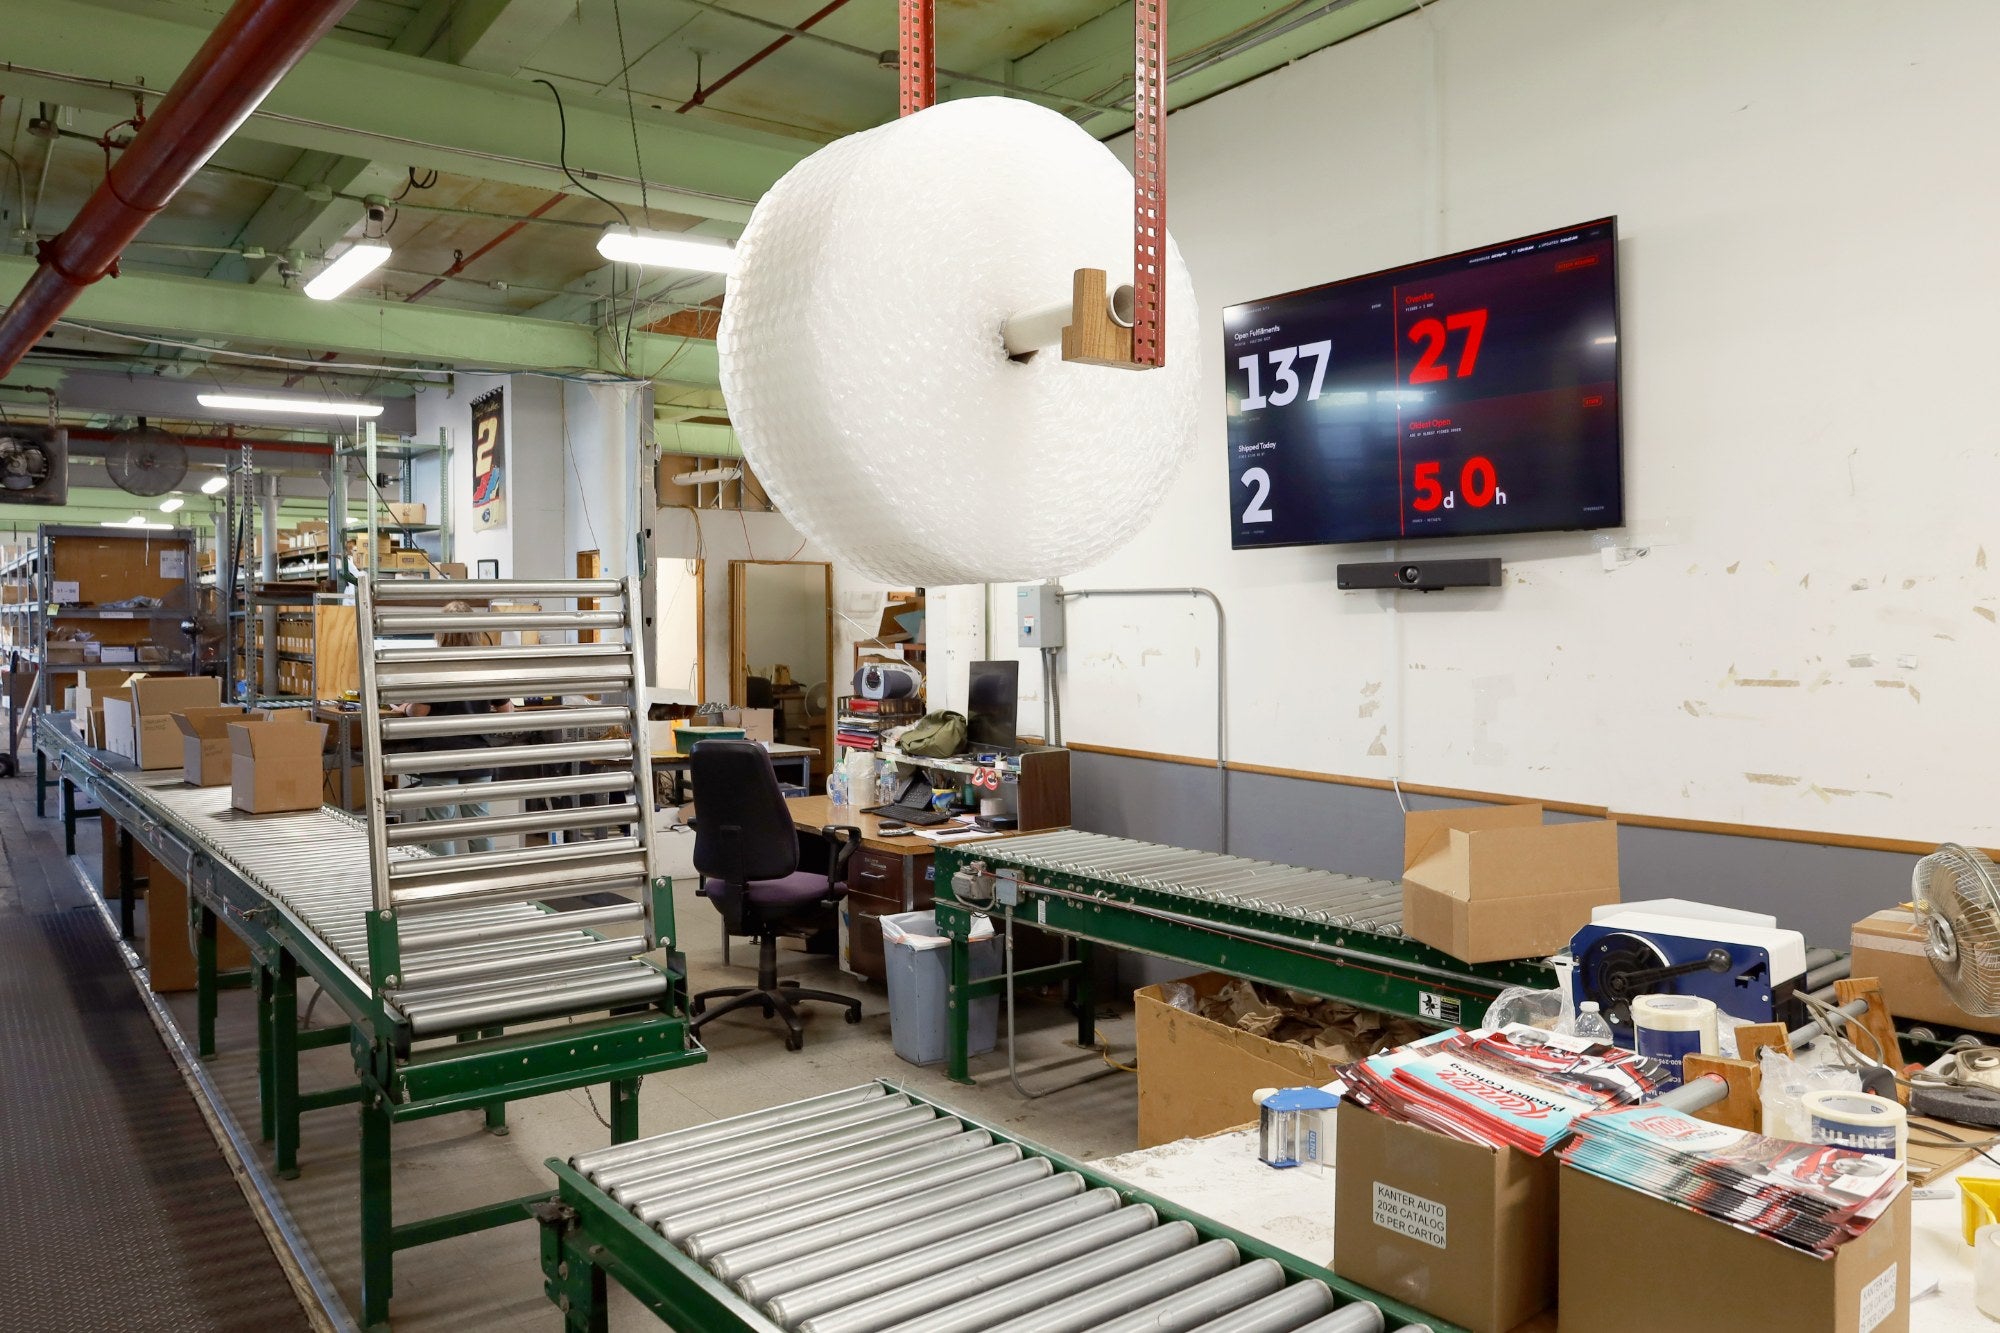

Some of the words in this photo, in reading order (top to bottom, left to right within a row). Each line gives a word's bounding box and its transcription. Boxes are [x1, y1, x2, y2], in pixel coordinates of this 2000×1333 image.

[1405, 293, 1435, 305] Overdue
[1234, 332, 1249, 341] Open
[1249, 324, 1281, 338] Fulfillments
[1408, 308, 1488, 385] 27
[1238, 339, 1332, 412] 137
[1409, 420, 1431, 430] Oldest
[1432, 418, 1452, 428] Open
[475, 416, 498, 478] 2
[1238, 443, 1260, 453] Shipped
[1260, 441, 1277, 450] Today
[1240, 467, 1273, 524] 2
[1450, 1063, 1505, 1091] Catalog
[1435, 1069, 1552, 1119] Kanter
[1505, 1088, 1566, 1113] Product
[1820, 1126, 1888, 1150] ULINE
[1377, 1199, 1398, 1215] 2026
[1399, 1207, 1445, 1232] CATALOG
[1378, 1186, 1415, 1208] KANTER
[1417, 1200, 1444, 1218] AUTO
[1374, 1211, 1385, 1223] 75
[1386, 1216, 1406, 1232] PER
